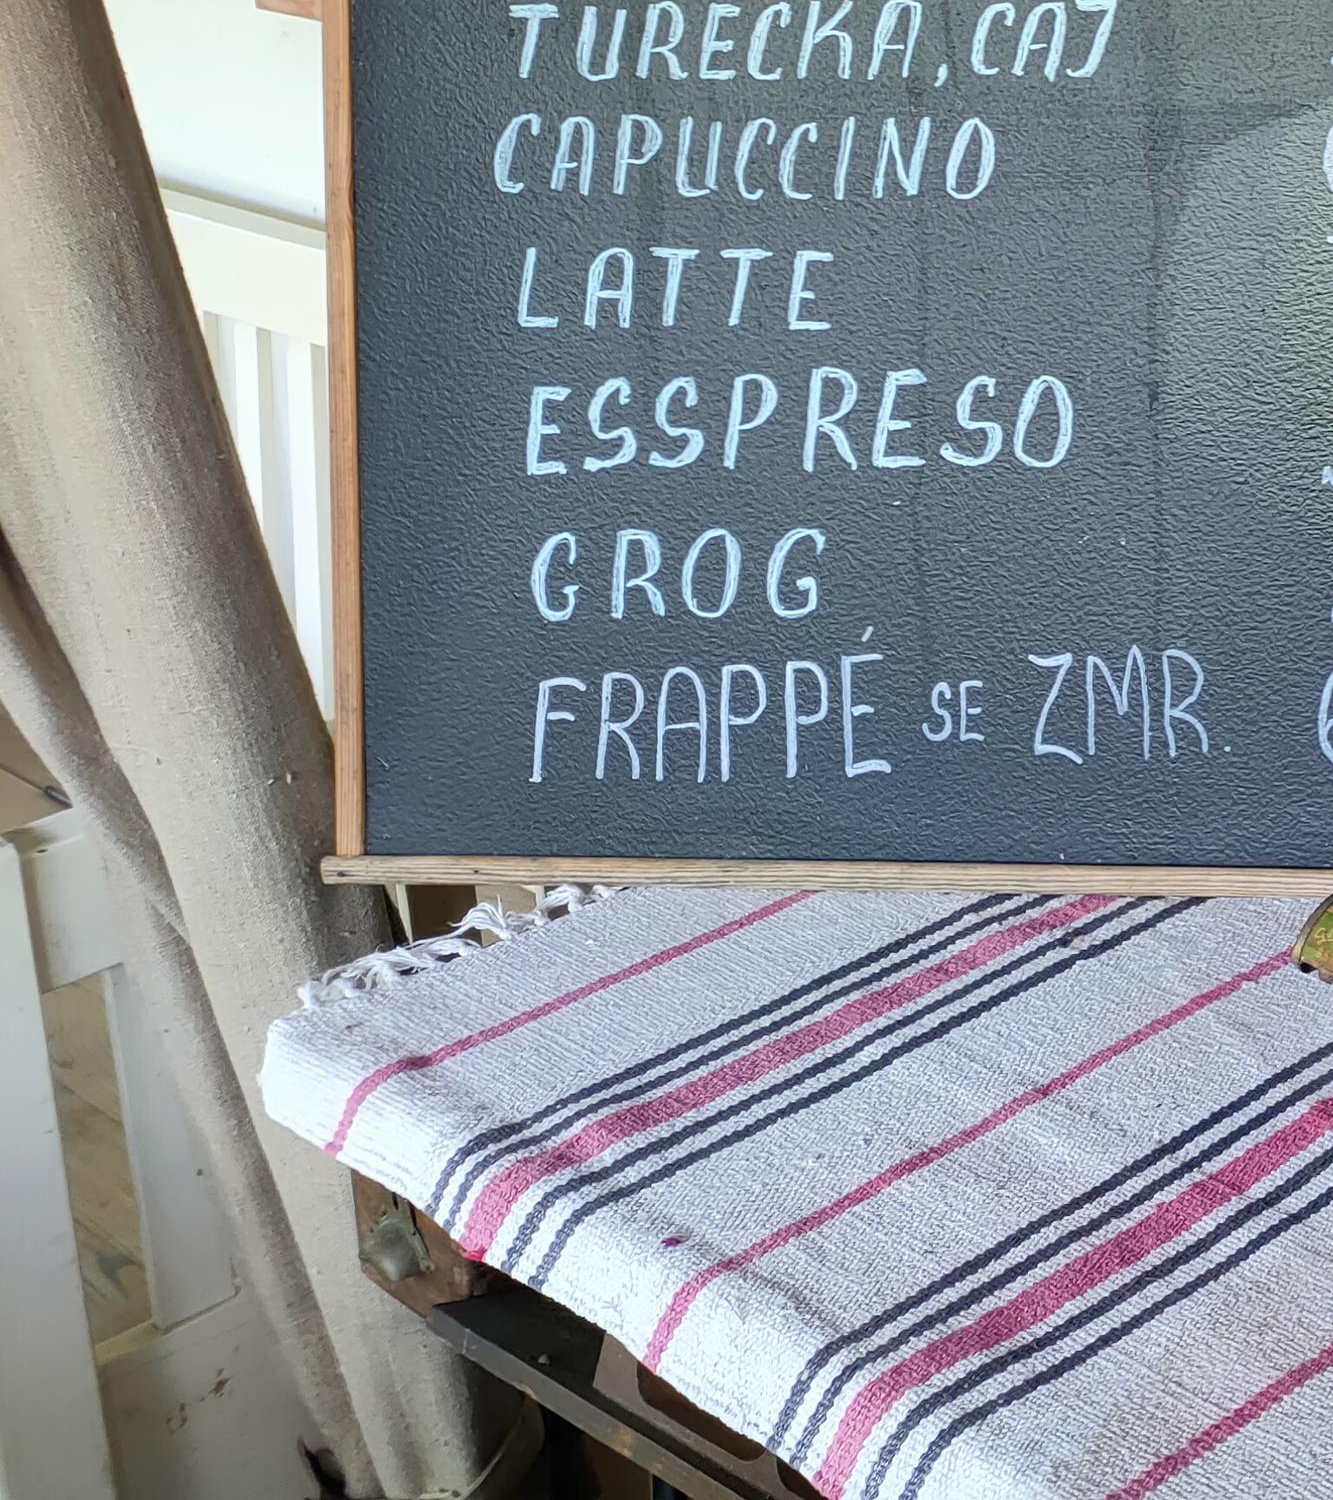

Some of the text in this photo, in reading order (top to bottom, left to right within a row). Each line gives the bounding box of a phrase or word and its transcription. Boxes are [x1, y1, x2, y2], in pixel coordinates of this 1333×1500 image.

[493, 114, 998, 200] CAPUCCINO
[516, 246, 834, 330] LATTE
[525, 366, 1075, 476] ESSPRESO
[531, 527, 826, 621] GROG
[531, 627, 891, 783] FRAPPÉ
